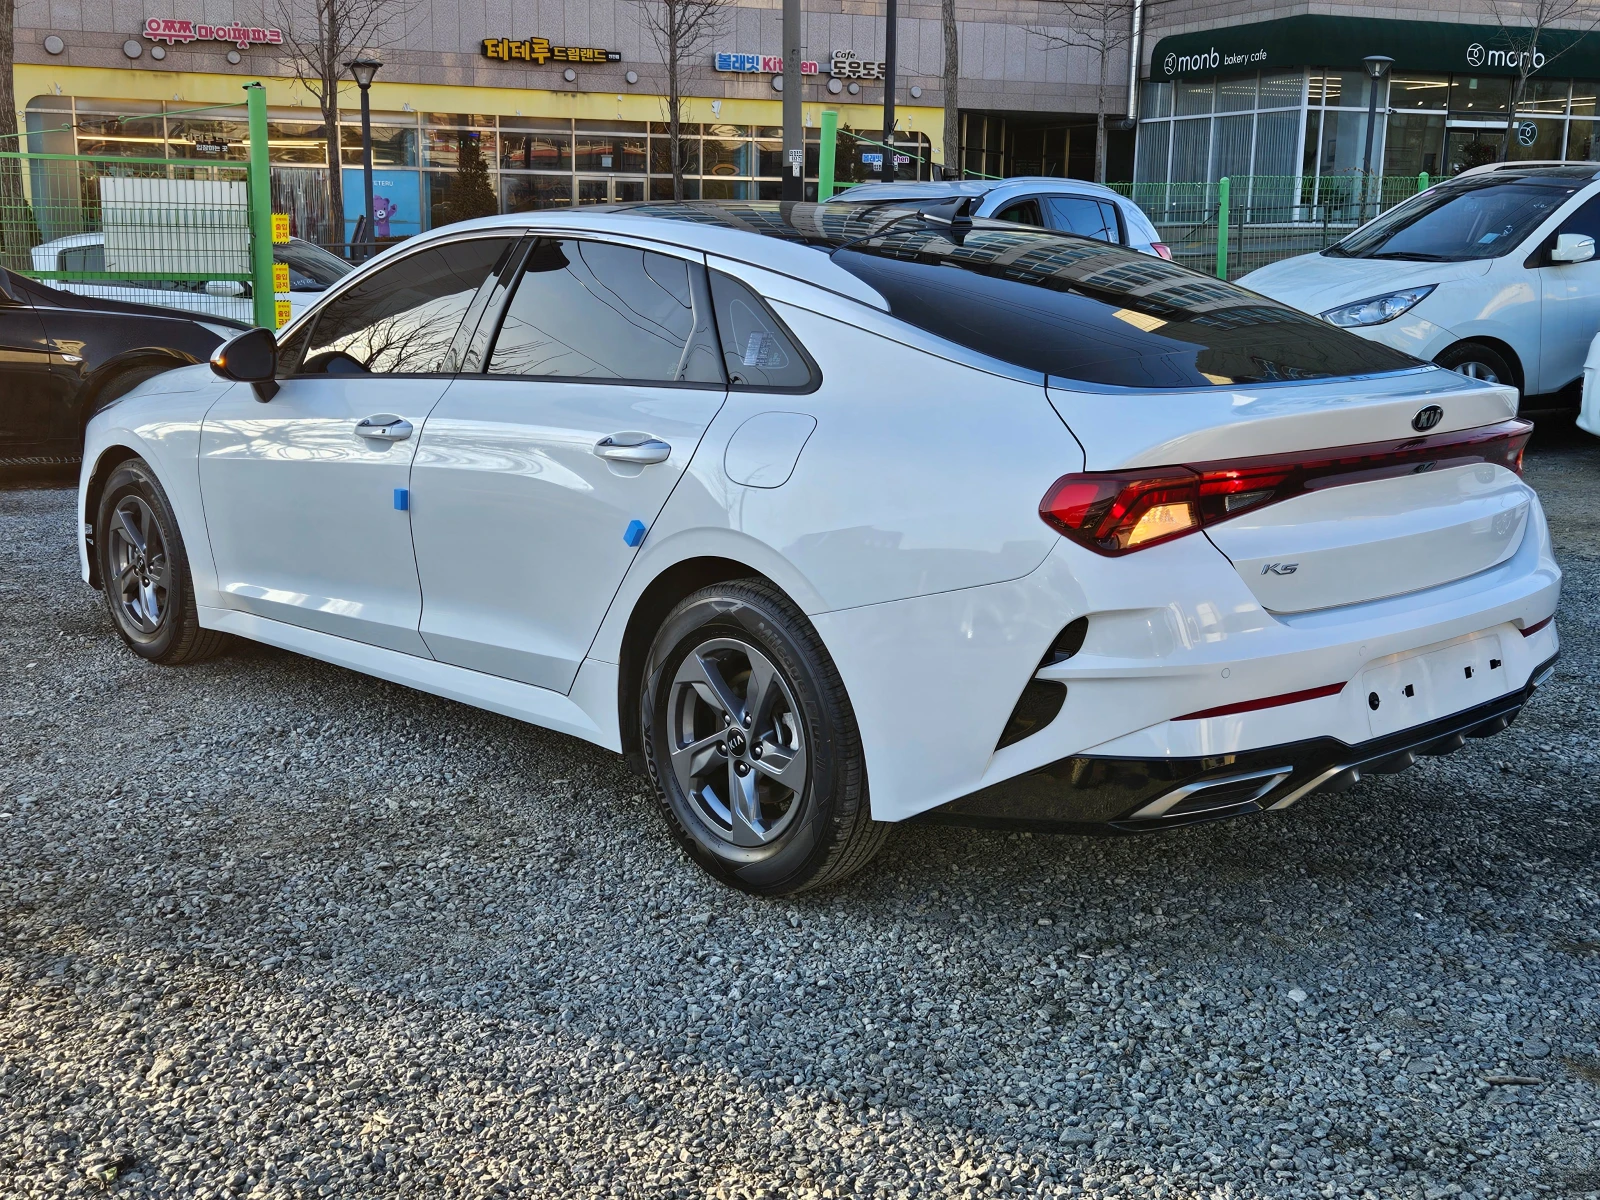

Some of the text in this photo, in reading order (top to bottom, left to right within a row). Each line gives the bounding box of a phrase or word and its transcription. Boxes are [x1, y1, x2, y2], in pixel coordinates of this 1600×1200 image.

[144, 18, 282, 48] 우쭈쭈 마이펫파크
[484, 37, 607, 64] 테테루 드림랜드
[835, 50, 856, 60] Cafe
[1178, 47, 1268, 72] monb bakery cafe
[718, 53, 818, 74] 볼래빗 Kiten
[1416, 409, 1443, 428] KIA
[1260, 562, 1299, 575] K5
[728, 735, 744, 750] KIA
